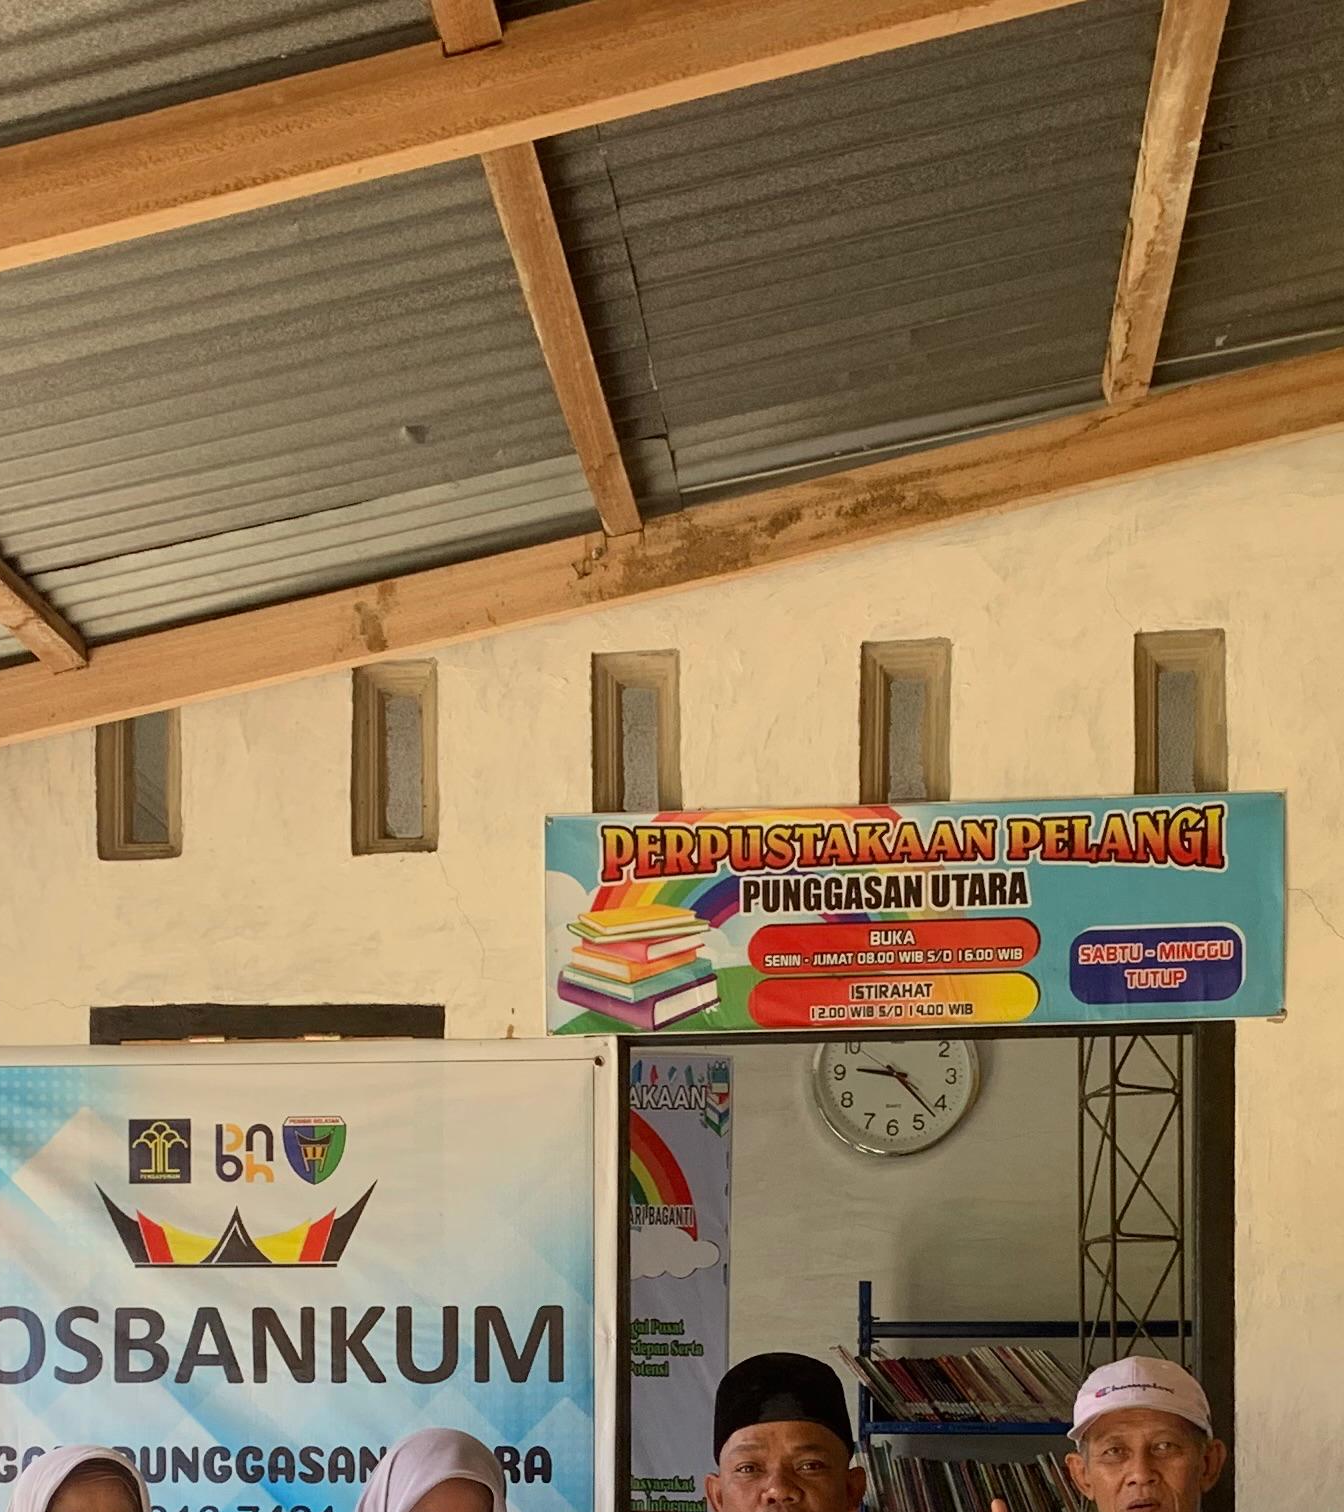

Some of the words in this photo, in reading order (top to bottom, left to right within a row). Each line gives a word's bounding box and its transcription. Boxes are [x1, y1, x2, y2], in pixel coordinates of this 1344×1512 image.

[601, 818, 997, 882] PERPUSTAKAAN
[1006, 804, 1225, 869] PELANGI
[742, 874, 923, 913] PUNGGASAN
[931, 871, 1029, 908] UTARA
[870, 930, 916, 946] BUKA
[764, 954, 801, 967] SENIN
[812, 953, 854, 966] JUMAT
[857, 952, 895, 965] 08.00
[898, 951, 924, 963] WIB
[927, 950, 952, 963] S/D
[958, 949, 994, 962] 16.00
[997, 948, 1023, 961] WIB
[1079, 943, 1143, 965] SABTU
[1157, 940, 1234, 962] MINGGU
[1124, 968, 1187, 988] TUTUP
[850, 982, 932, 1000] ISTIRAHAT
[810, 1006, 846, 1020] 12.00
[850, 1005, 875, 1018] WIB
[878, 1004, 903, 1018] S/D
[908, 1003, 944, 1017] 14.00
[948, 1002, 973, 1015] WIB
[845, 1042, 861, 1054] 10
[938, 1041, 950, 1057] 2
[834, 1064, 846, 1081] 9
[945, 1068, 957, 1084] 3
[841, 1091, 853, 1108] 8
[934, 1095, 947, 1111] 4
[864, 1113, 876, 1129] 7
[886, 1119, 899, 1136] 6
[913, 1114, 925, 1130] 5
[649, 1206, 694, 1225] BAGANTI
[670, 1339, 704, 1356] Serta
[630, 1475, 695, 1497] asyarakat
